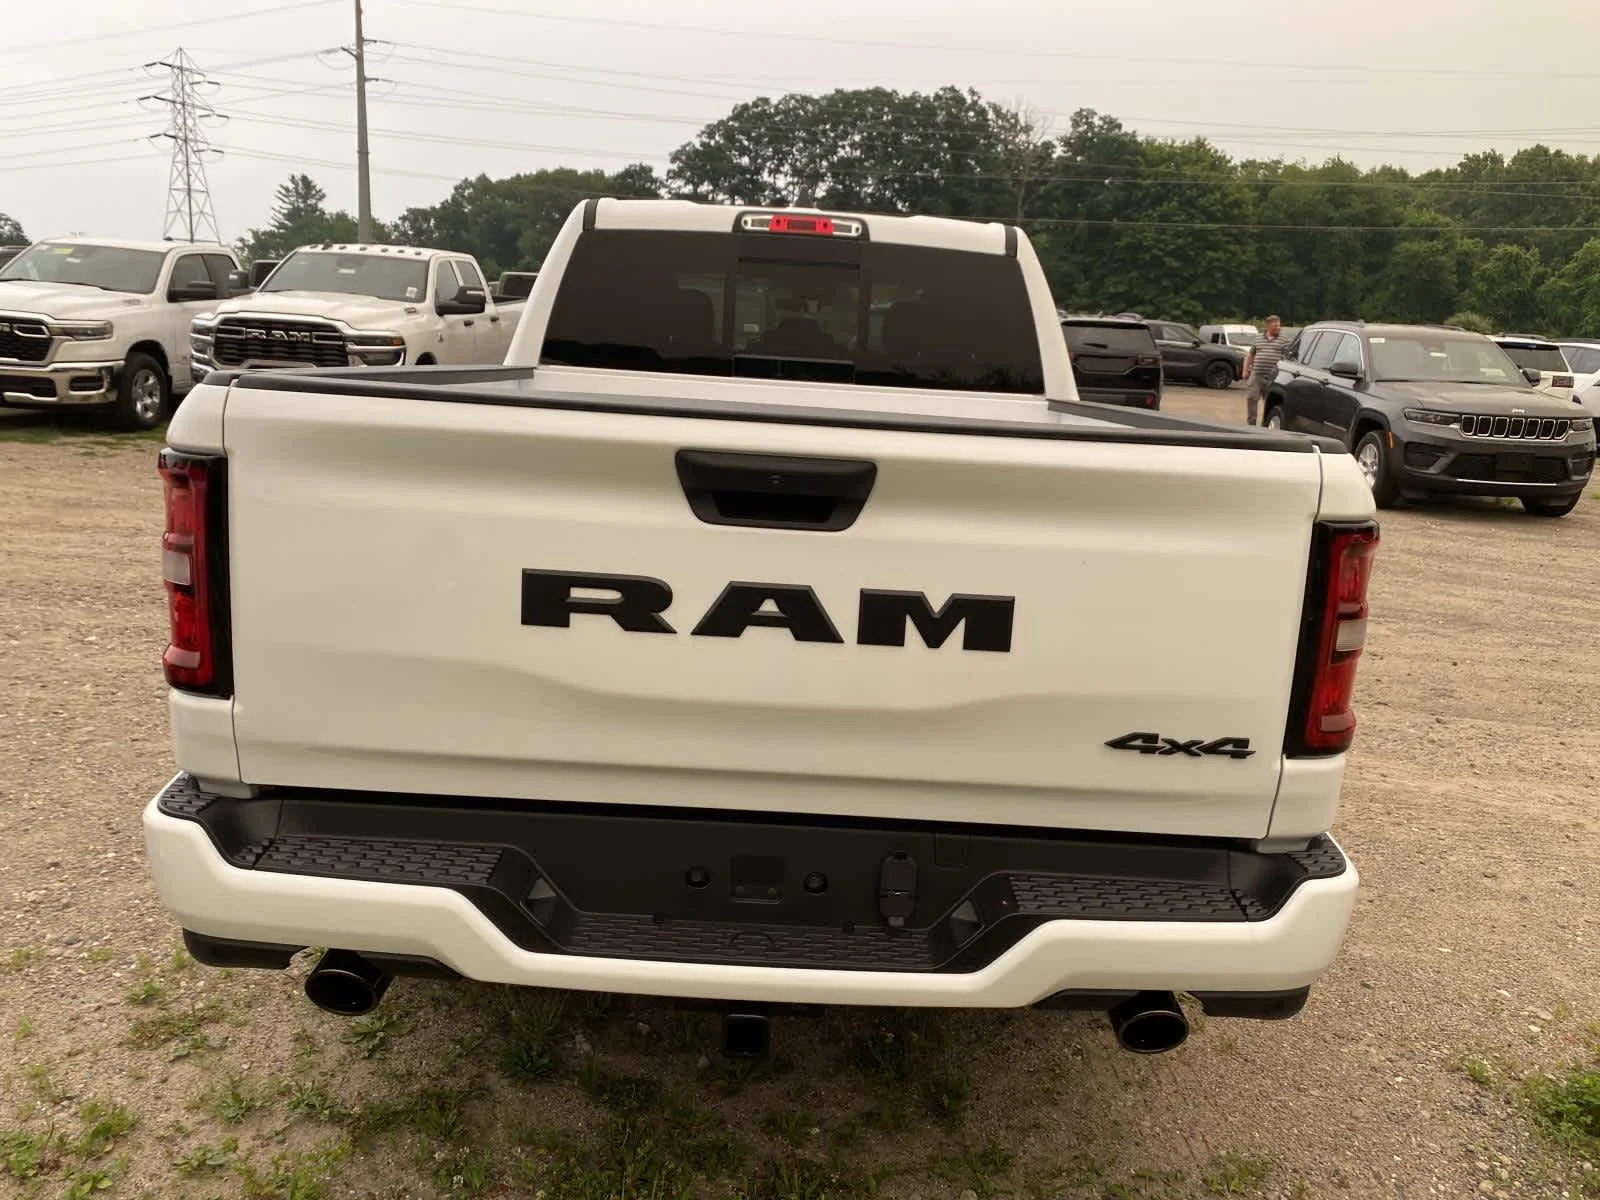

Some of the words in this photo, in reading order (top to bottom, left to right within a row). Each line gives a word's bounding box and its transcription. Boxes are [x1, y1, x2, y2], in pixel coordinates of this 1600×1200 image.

[246, 328, 311, 343] RAM
[521, 568, 1015, 652] RAM
[1104, 732, 1256, 758] 4x4
